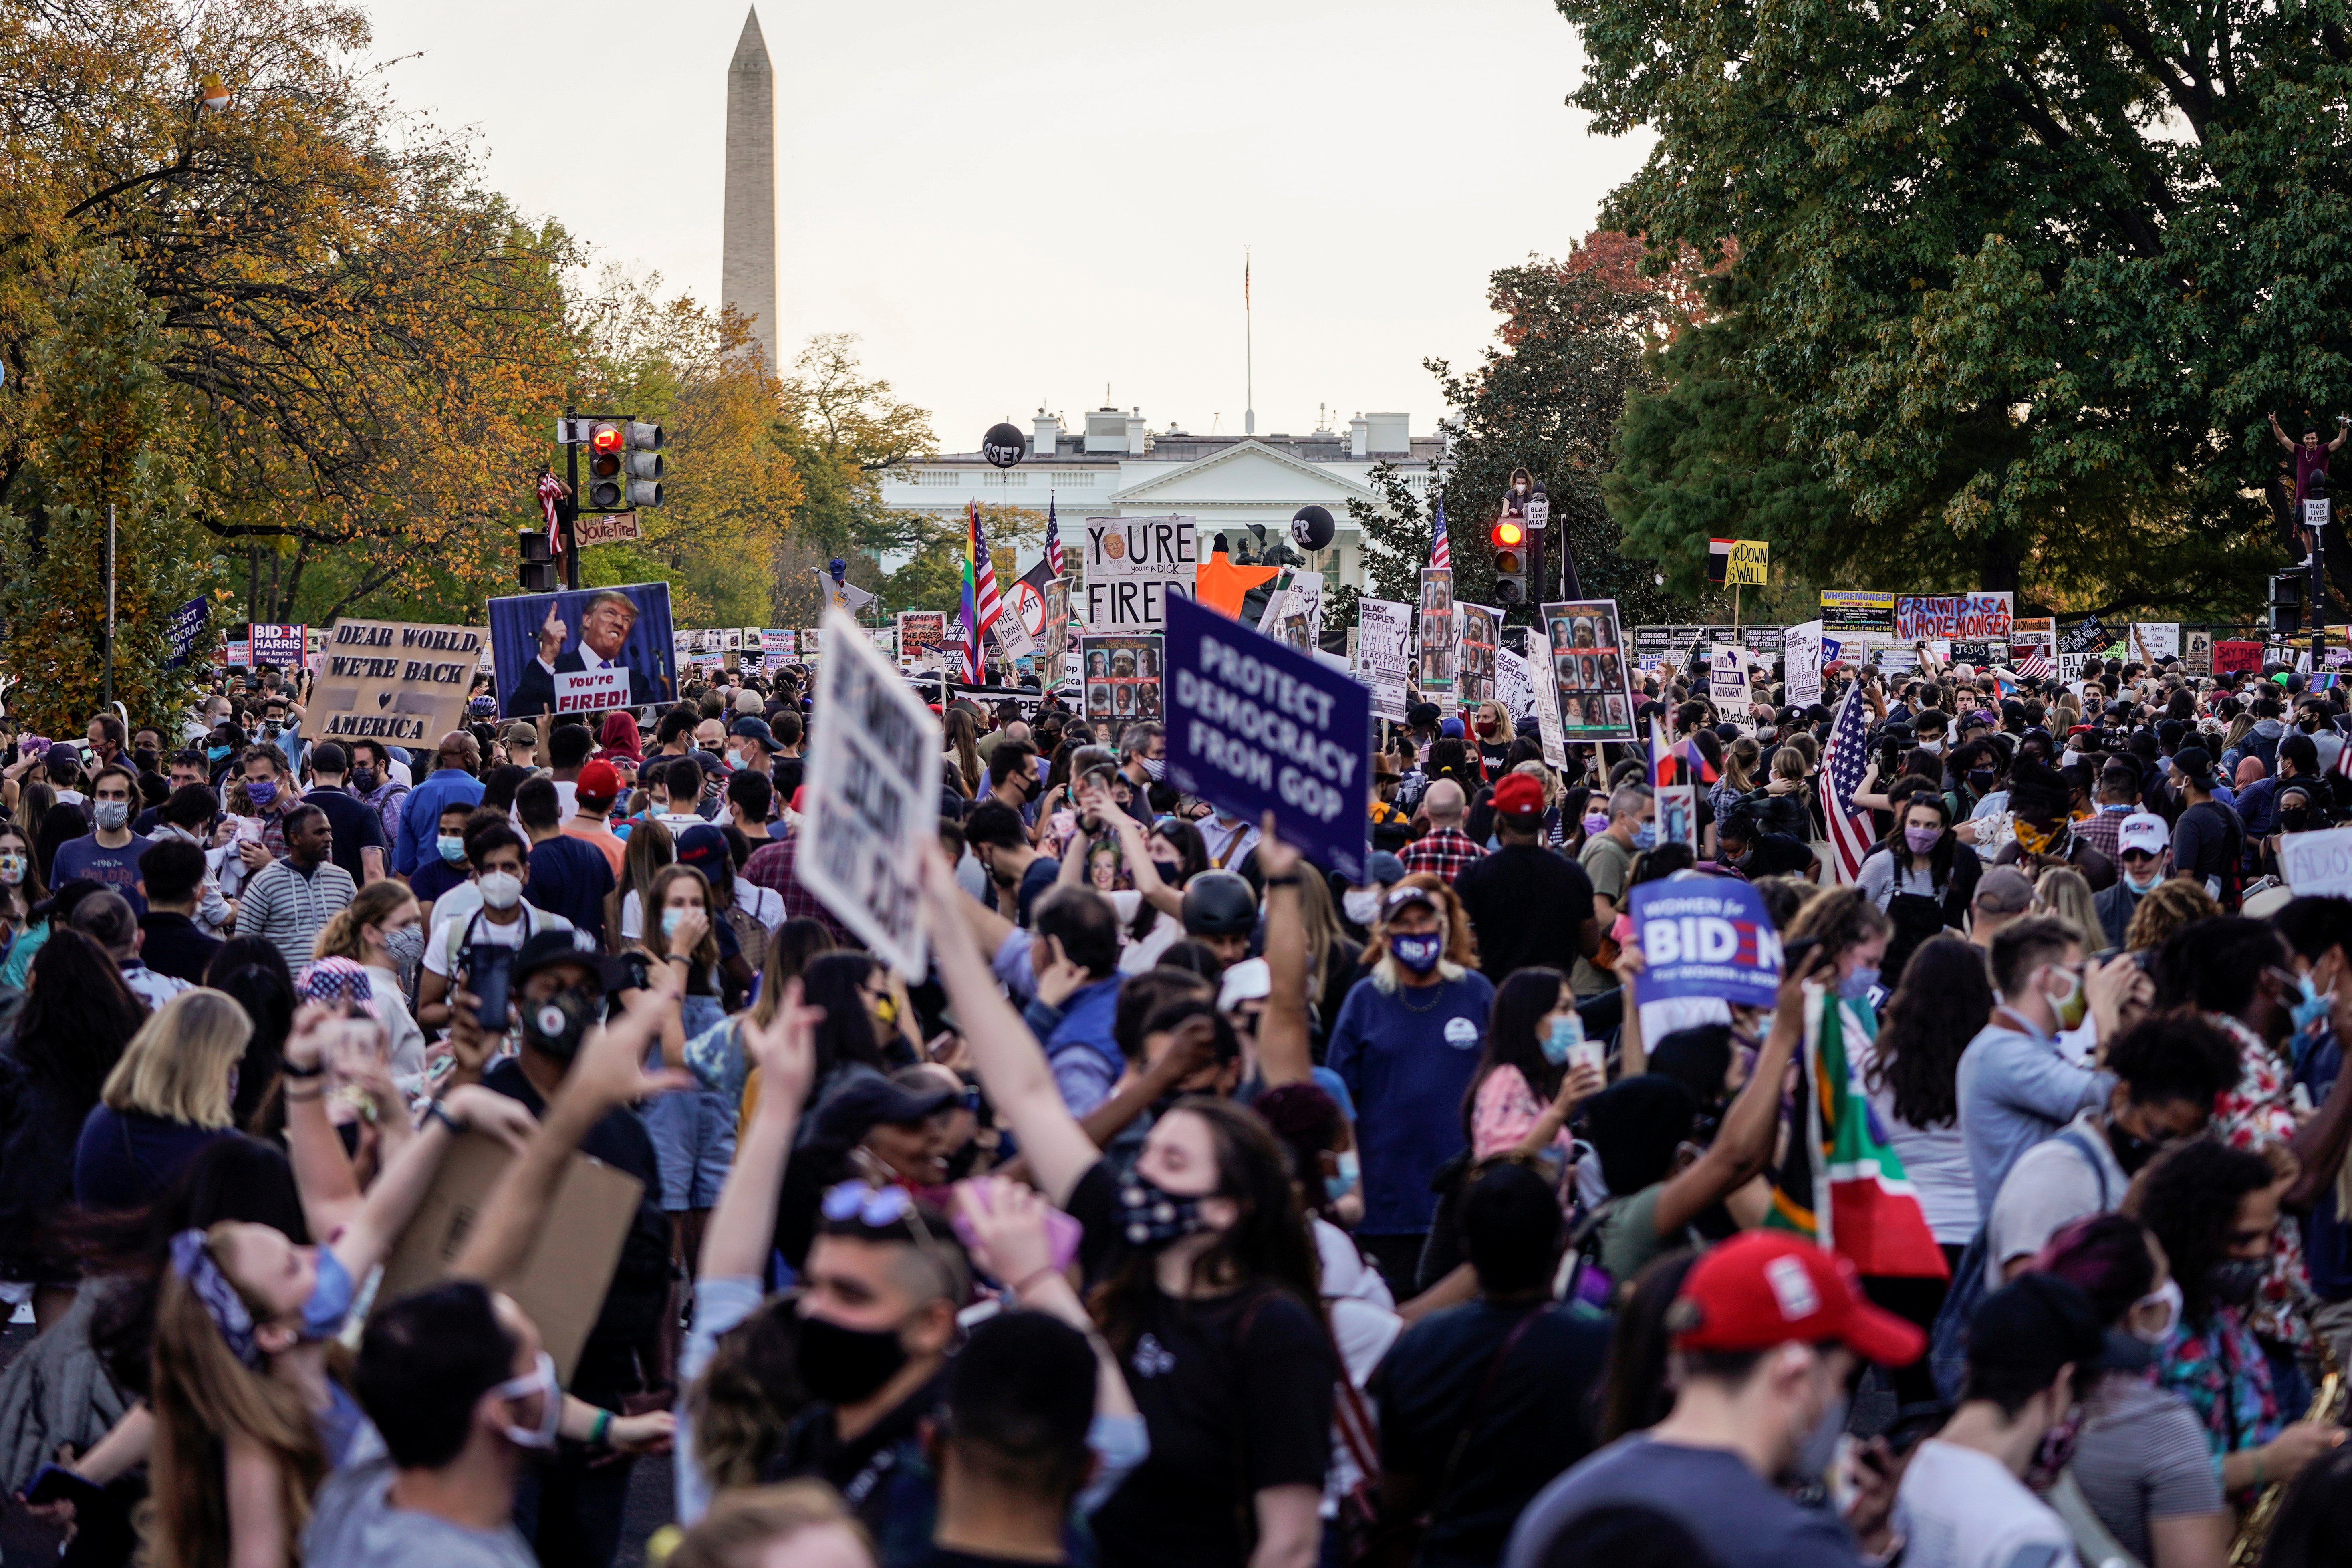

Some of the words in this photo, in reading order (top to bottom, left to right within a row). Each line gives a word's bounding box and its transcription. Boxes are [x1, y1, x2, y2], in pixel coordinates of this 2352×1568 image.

[1088, 523, 1195, 565] YU'RE
[1741, 544, 1767, 563] DOWN
[1823, 591, 1892, 601] WHOREMONGER
[1362, 603, 1387, 614] BLACK
[1973, 597, 1995, 613] IS
[1996, 598, 2008, 614] A
[997, 609, 1014, 626] BYE
[1362, 612, 1395, 624] PEOPLE'S
[255, 625, 302, 638] BIDEN
[1002, 621, 1022, 639] DON!
[1362, 621, 1391, 633] MARCH
[1897, 614, 2011, 639] WHOREMONGER
[2058, 634, 2072, 647] SEX
[2072, 628, 2080, 636] IS
[2079, 614, 2098, 631] GREAT
[255, 639, 301, 649] HARRIS
[335, 624, 393, 647] DEAR
[403, 628, 481, 655] WORLD,
[1006, 635, 1023, 650] #GTFO
[1362, 633, 1391, 645] WHITE
[1787, 630, 1799, 641] BLACK
[2061, 644, 2070, 653] BUT
[2070, 635, 2083, 646] HAVE
[2082, 627, 2093, 637] YOU
[2073, 638, 2087, 651] EVER
[2086, 627, 2101, 640] TRIED
[1362, 641, 1393, 654] HOUSE
[2218, 647, 2237, 659] SAY
[1361, 651, 1382, 660] BLACK
[1384, 656, 1405, 665] POWER
[1373, 660, 1405, 672] MATTERS:
[1498, 653, 1521, 670] BLACK
[332, 656, 399, 678] WE'RE
[403, 661, 465, 683] BACK
[1497, 661, 1528, 681] EOPLE'S
[1714, 671, 1740, 683] SOLIDARITY
[1799, 671, 1818, 682] POWER
[569, 674, 613, 689] You're
[1200, 635, 1336, 731] PROTECT
[558, 690, 628, 712] FIRED!
[1715, 687, 1742, 698] MOVEMENT
[1721, 707, 1754, 730] Petersburg
[324, 715, 423, 740] AMERICA
[1175, 667, 1358, 788] DEMOCRACY
[1188, 720, 1273, 792] FROM
[1278, 765, 1343, 823] GOP
[1642, 896, 1722, 918] WOMEN
[1723, 898, 1747, 919] for
[1644, 916, 1785, 969] BIDEN
